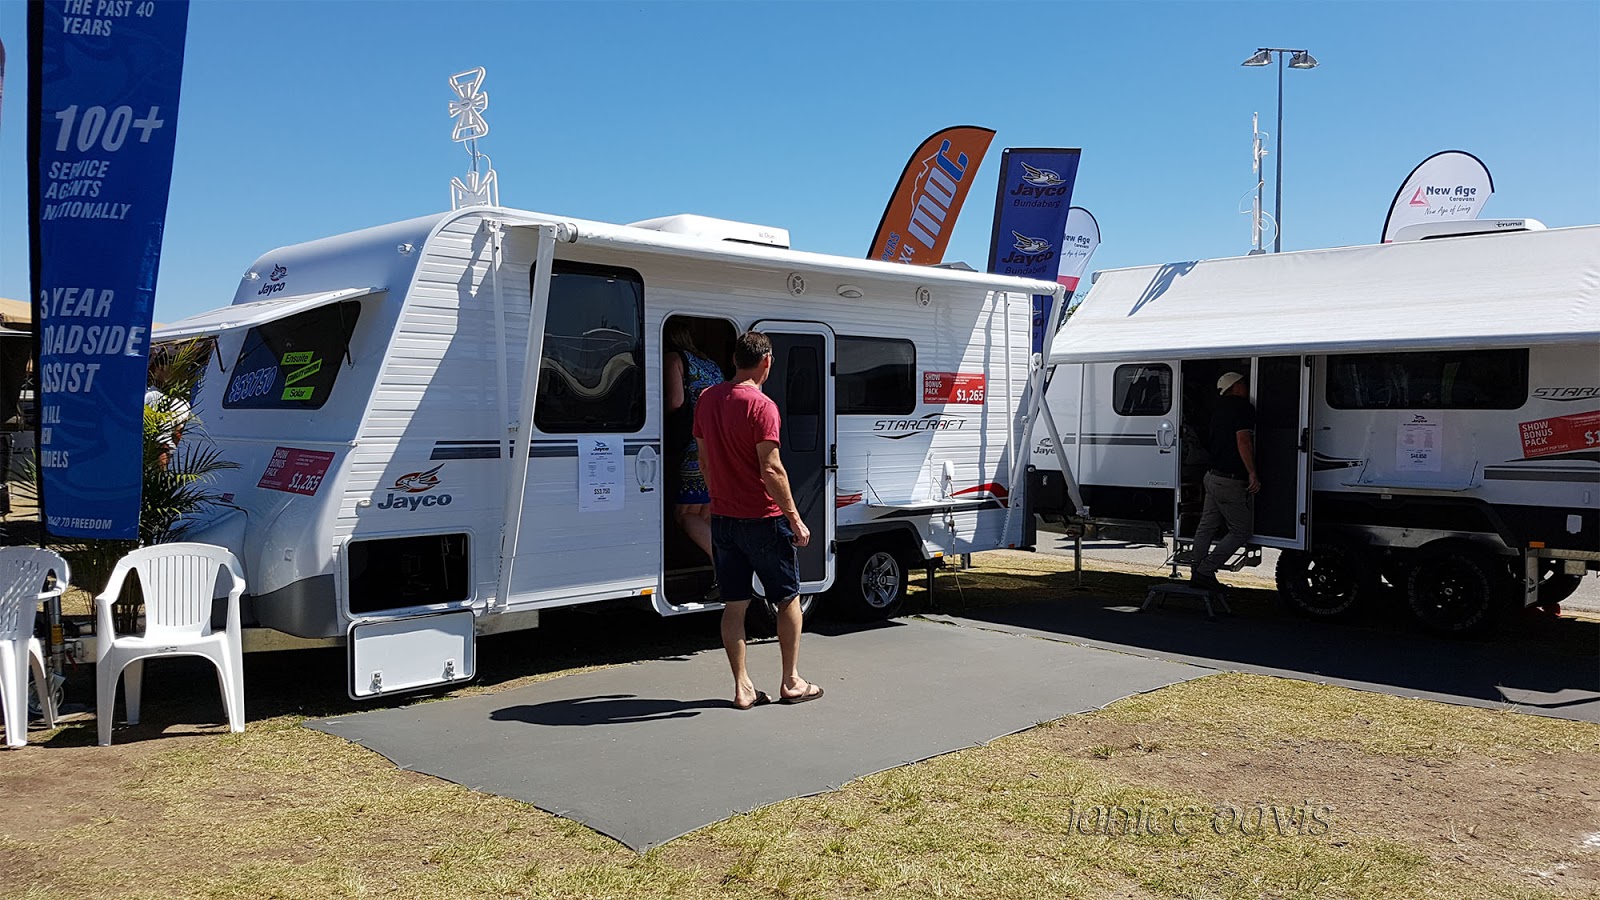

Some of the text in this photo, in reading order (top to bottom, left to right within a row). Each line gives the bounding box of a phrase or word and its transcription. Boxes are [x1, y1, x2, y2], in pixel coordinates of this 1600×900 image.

[64, 0, 154, 17] THE PAST 40
[62, 17, 112, 36] YEARS
[56, 104, 164, 152] 100+
[1010, 183, 1066, 198] Jayco
[1426, 186, 1477, 197] New Age
[1014, 199, 1061, 208] Bundaberg
[1438, 206, 1448, 216] Age
[1450, 205, 1456, 215] of
[1457, 205, 1471, 215] Living
[1078, 236, 1090, 244] Age
[1002, 251, 1054, 266] Jayco
[1004, 264, 1047, 275] Bundaberg
[258, 282, 286, 296] Jayco
[40, 288, 114, 319] 3 YEAR
[286, 354, 309, 362] Ensuite
[290, 389, 305, 397] Solar
[956, 389, 984, 403] $1,265
[873, 420, 968, 431] STARCRAFT
[1522, 421, 1549, 432] SHOW
[1524, 428, 1553, 439] BONUS
[1525, 437, 1548, 446] PACK
[1034, 446, 1055, 455] Jayc
[41, 450, 69, 468] DELS
[288, 472, 321, 491] $1,265
[378, 492, 452, 512] Jayco
[71, 518, 112, 530] FREEDOM
